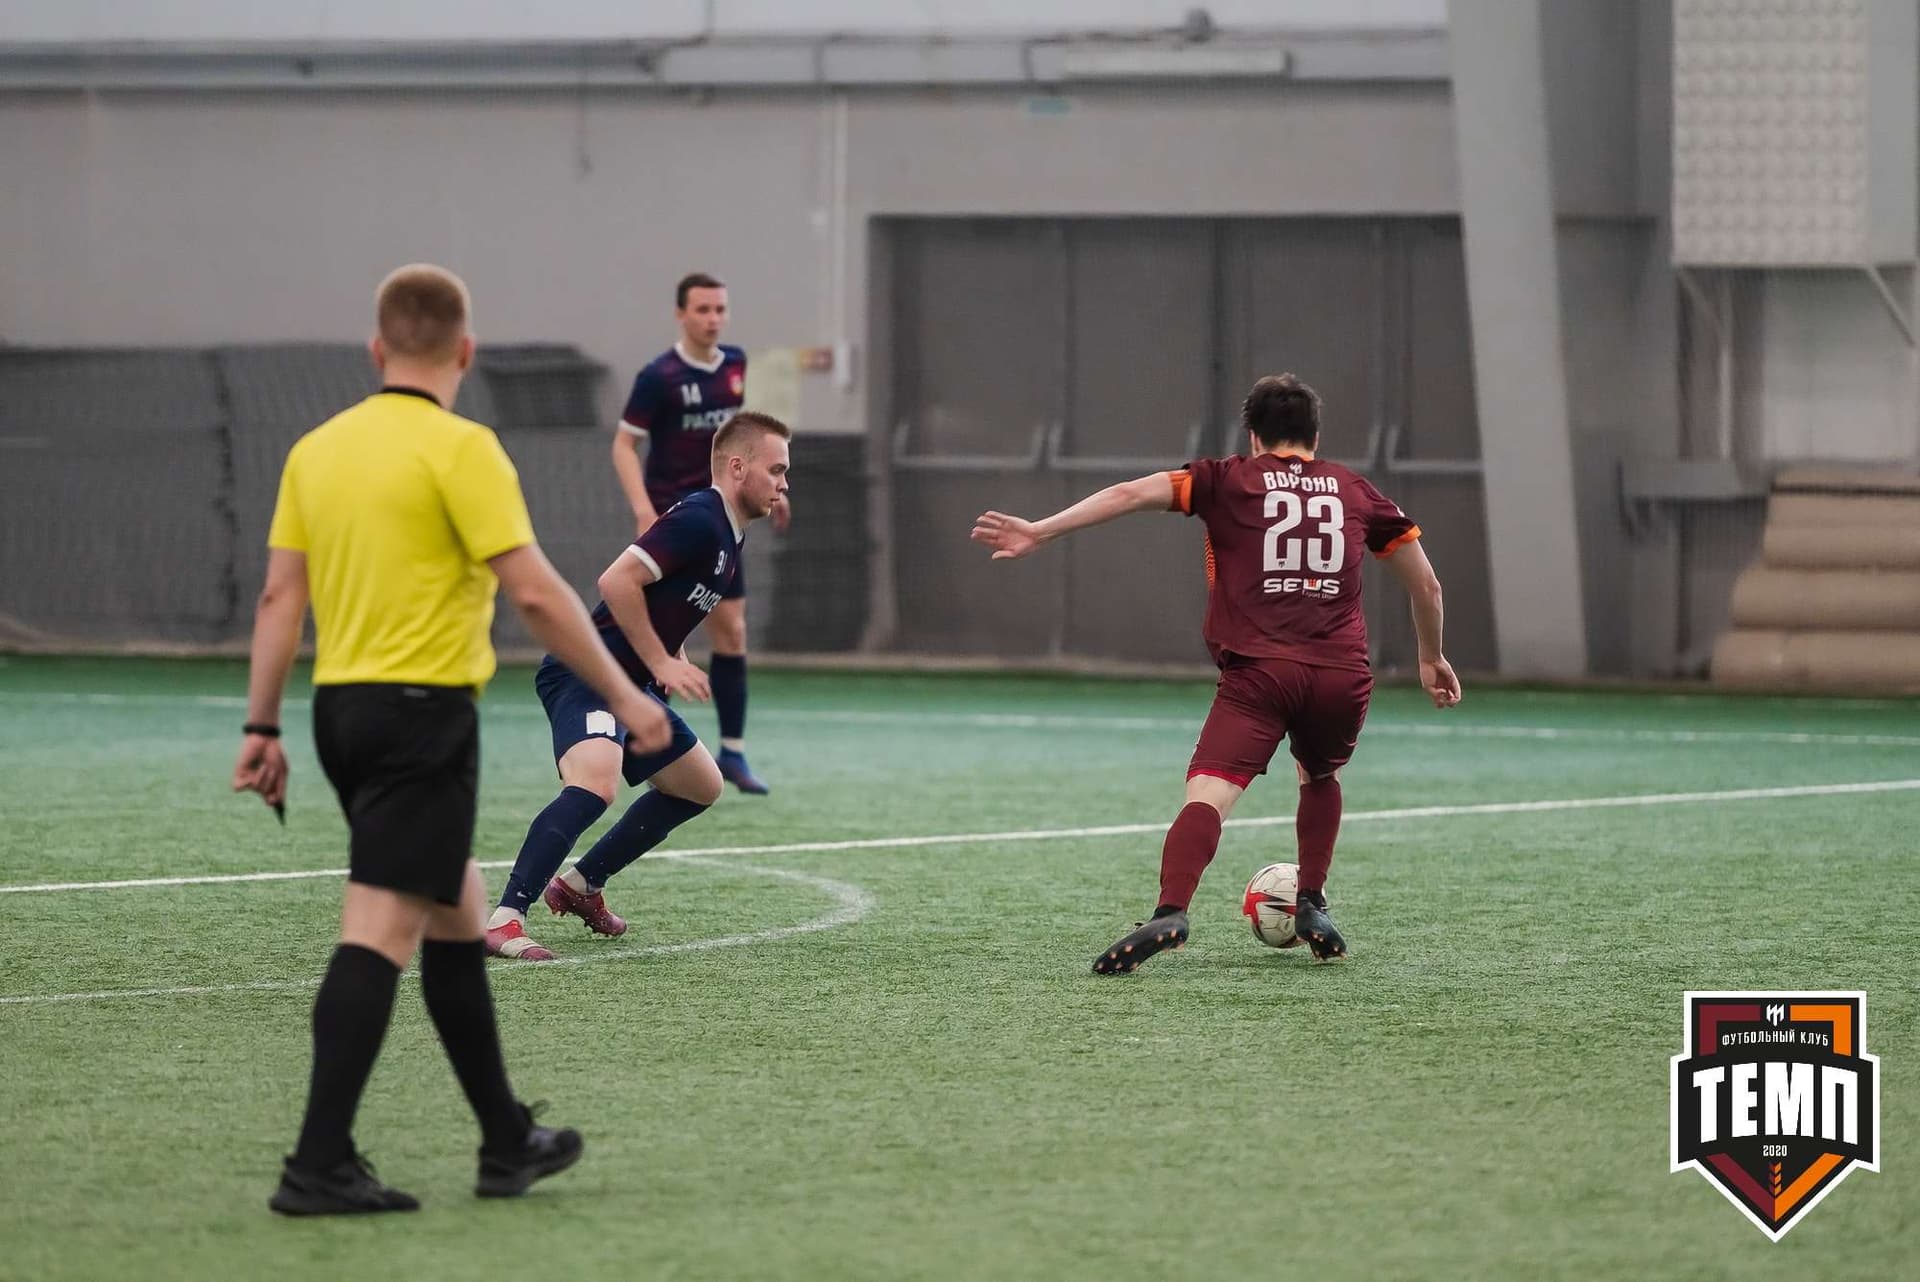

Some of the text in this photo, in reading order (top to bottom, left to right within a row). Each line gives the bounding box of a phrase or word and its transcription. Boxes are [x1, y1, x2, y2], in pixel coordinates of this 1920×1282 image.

[681, 382, 703, 407] 14
[1263, 471, 1339, 493] ВОРОНА
[1263, 490, 1345, 574] 23
